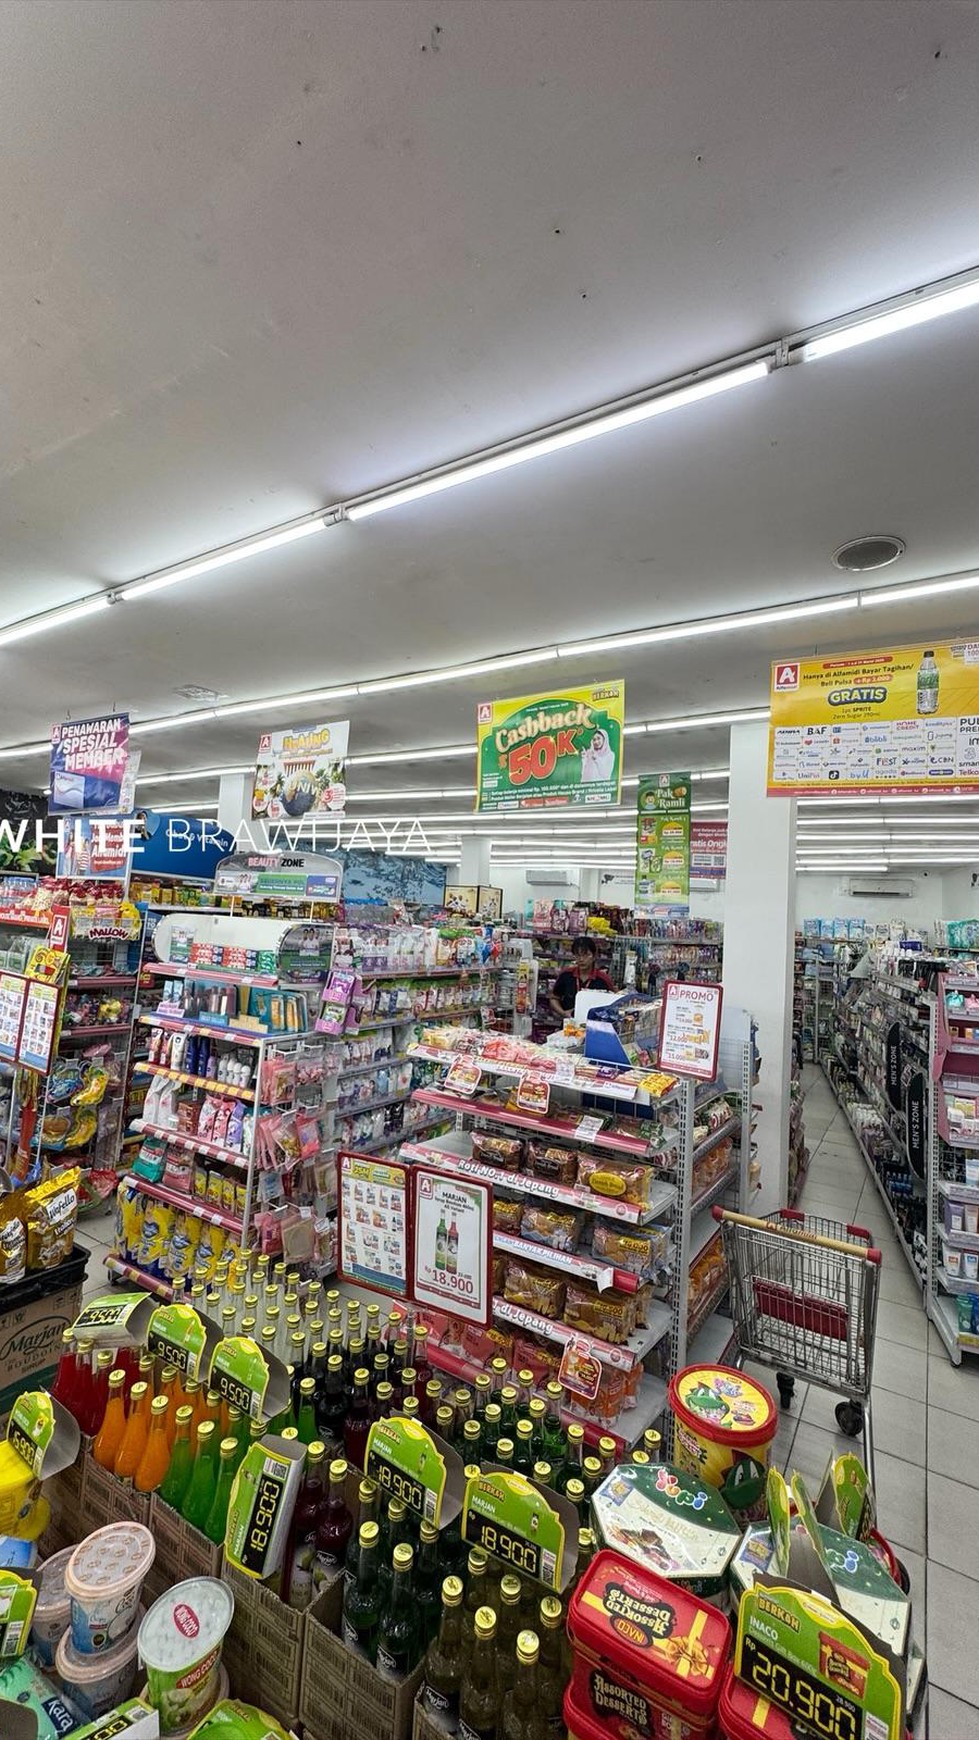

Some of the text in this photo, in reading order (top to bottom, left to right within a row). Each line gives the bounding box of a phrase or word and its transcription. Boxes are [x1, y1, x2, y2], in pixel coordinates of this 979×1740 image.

[832, 669, 861, 678] Alfamidi
[862, 667, 882, 675] Bayar
[883, 663, 914, 673] Tagihan/
[829, 688, 885, 703] GRATIS
[61, 717, 121, 739] PENAWARAN
[495, 703, 596, 753] Cashback
[847, 712, 862, 720] Sugar
[62, 731, 118, 755] SPESIAL
[807, 726, 827, 735] BAF
[64, 747, 127, 772] MEMBER
[656, 788, 674, 799] Pak
[658, 798, 686, 808] Ramli
[247, 856, 305, 868] BEAUTY ZONE
[89, 926, 129, 938] MALLOW
[679, 989, 715, 1002] PROMO
[890, 1066, 898, 1087] MEN'S
[912, 1100, 920, 1149] MEN'S ZONE
[457, 1159, 478, 1174] Roti
[507, 1173, 517, 1185] di
[517, 1176, 560, 1198] Jepang
[49, 1193, 75, 1220] Wafello
[442, 1191, 467, 1204] MARJAN
[542, 1249, 573, 1264] PILIHAN
[432, 1269, 474, 1294] 18.900
[499, 1303, 554, 1335] di Jepang
[157, 1341, 187, 1370] 9.500
[220, 1377, 250, 1411] 9.500
[378, 1464, 422, 1510] 18.900
[250, 1480, 280, 1552] 18.900
[472, 1494, 496, 1513] MARJAN
[481, 1525, 537, 1574] 18.900
[605, 1599, 670, 1637] ASSORTED
[608, 1588, 671, 1624] DESSERTS
[757, 1598, 800, 1633] BERKAH
[617, 1619, 646, 1644] INACO
[749, 1615, 779, 1641] INACO
[180, 1669, 201, 1688] WONG
[593, 1673, 647, 1709] ASSORTED
[745, 1637, 856, 1740] Rp 20.900
[48, 1698, 74, 1733] Kara
[595, 1690, 648, 1725] DESSERTS
